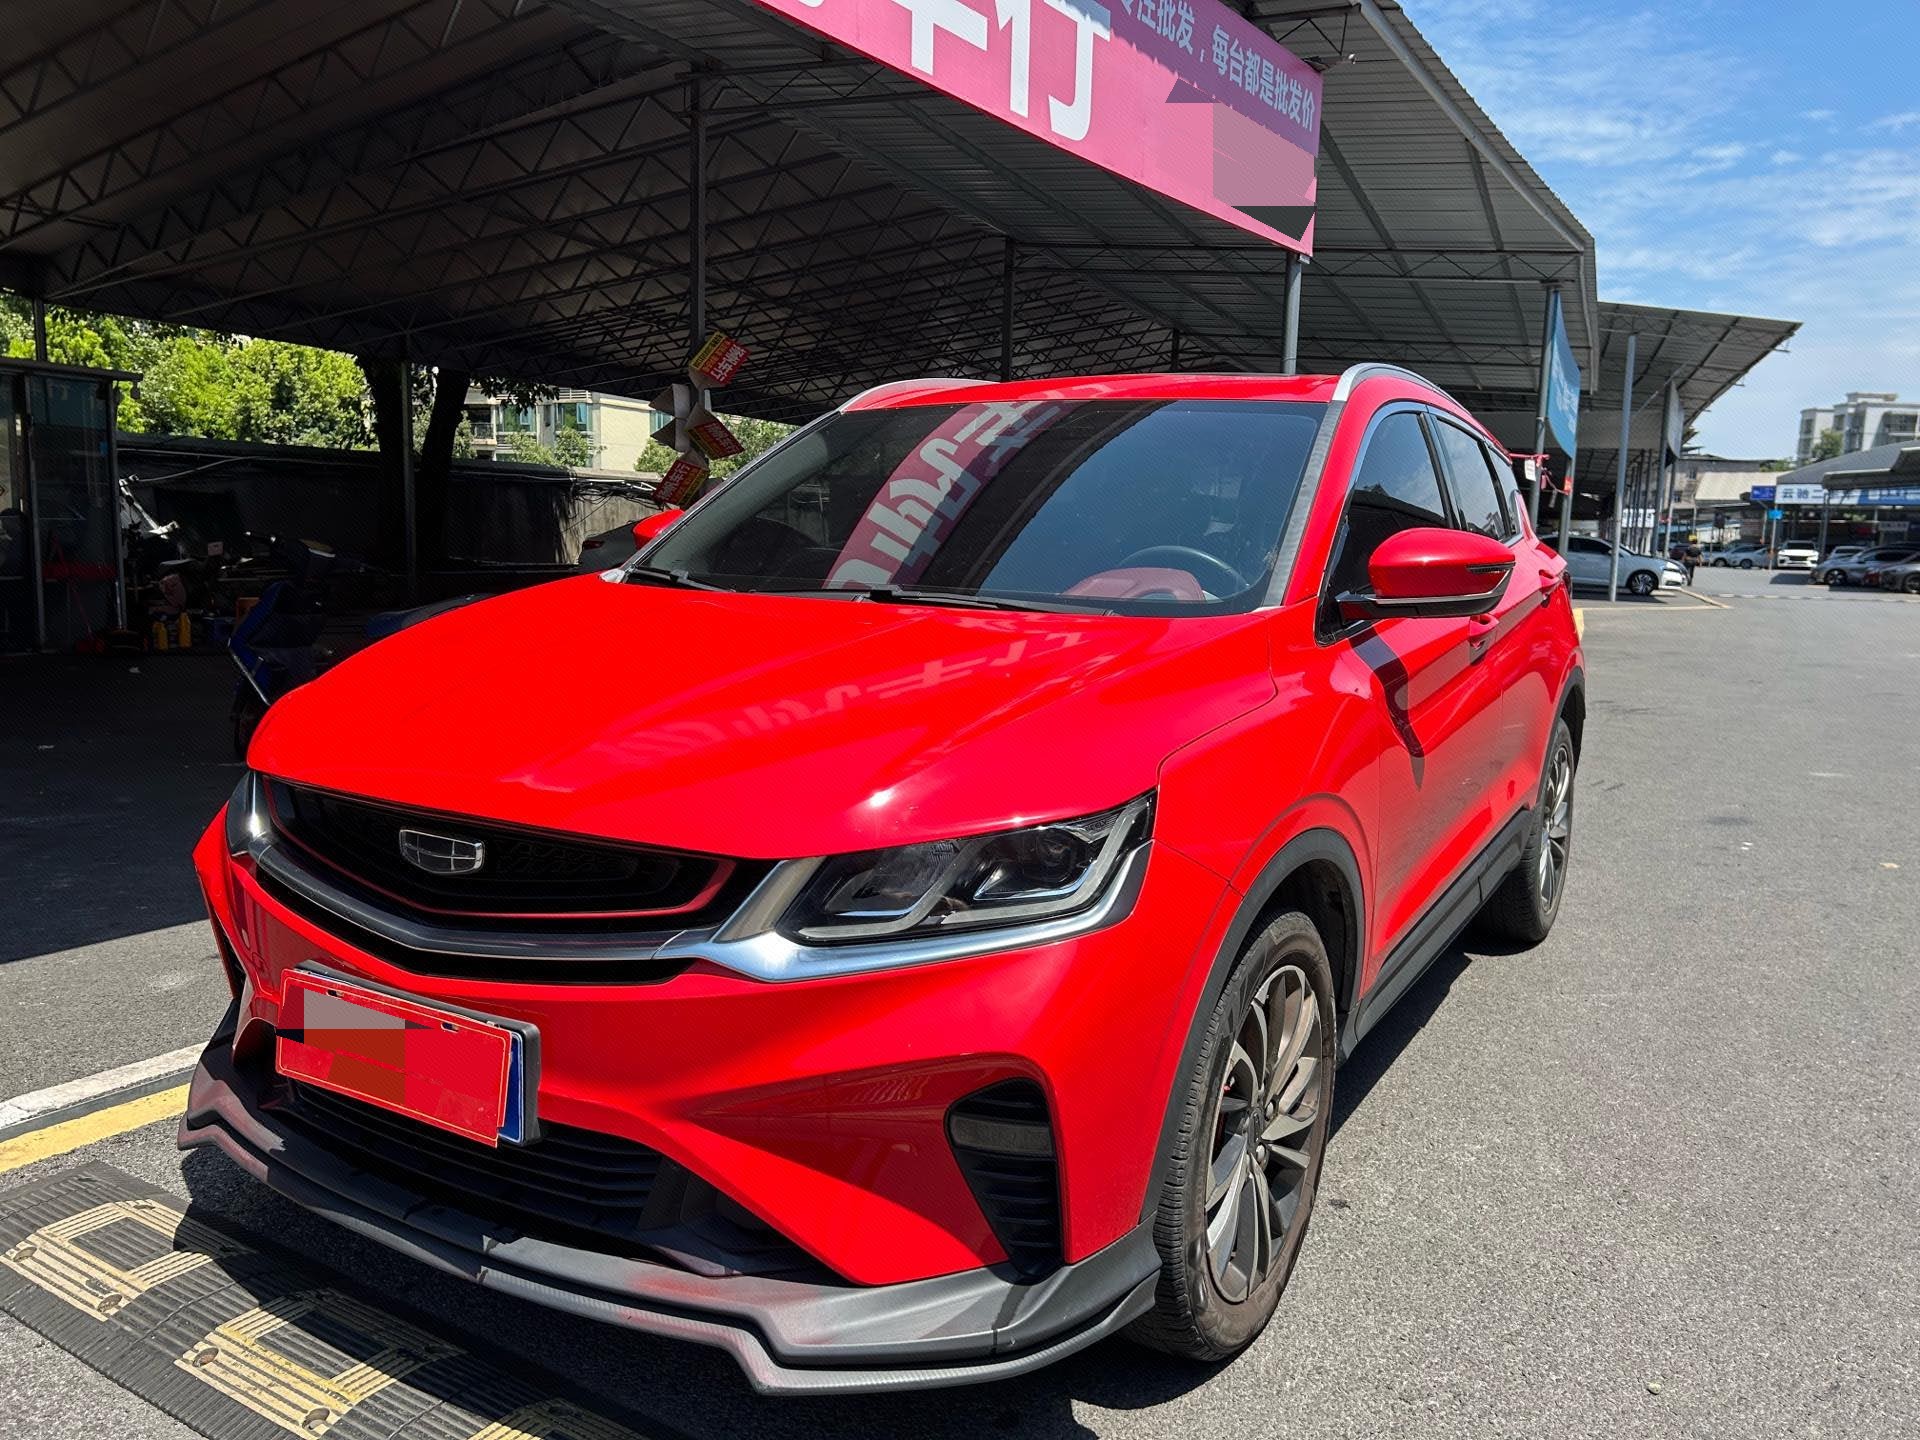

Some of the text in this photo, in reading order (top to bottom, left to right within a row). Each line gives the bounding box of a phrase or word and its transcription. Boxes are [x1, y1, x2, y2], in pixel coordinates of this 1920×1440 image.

[1121, 0, 1315, 132] 注批发，每台都是批发价
